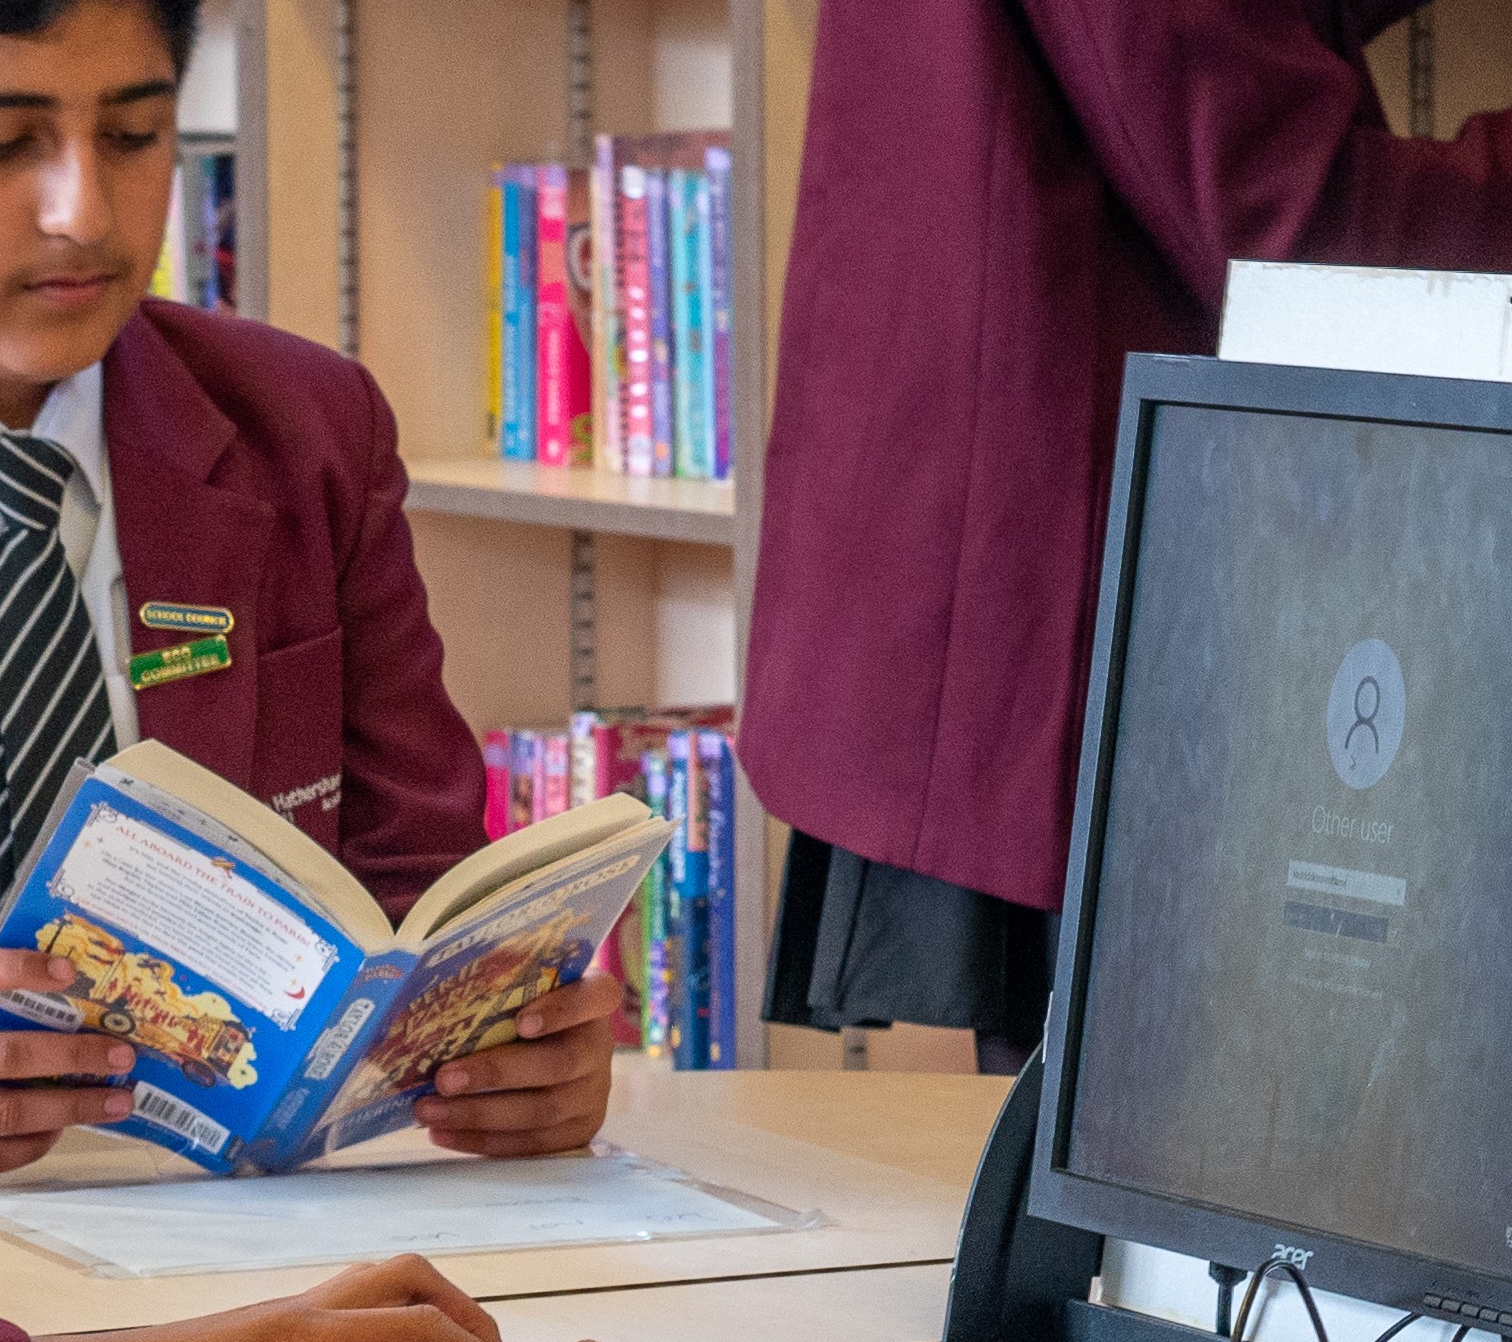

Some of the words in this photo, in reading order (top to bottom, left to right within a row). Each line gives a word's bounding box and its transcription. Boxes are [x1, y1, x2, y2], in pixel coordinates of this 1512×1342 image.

[1311, 805, 1355, 837] Other
[1360, 819, 1394, 844] user
[140, 838, 193, 869] ABOARD
[1271, 1243, 1314, 1270] acer
